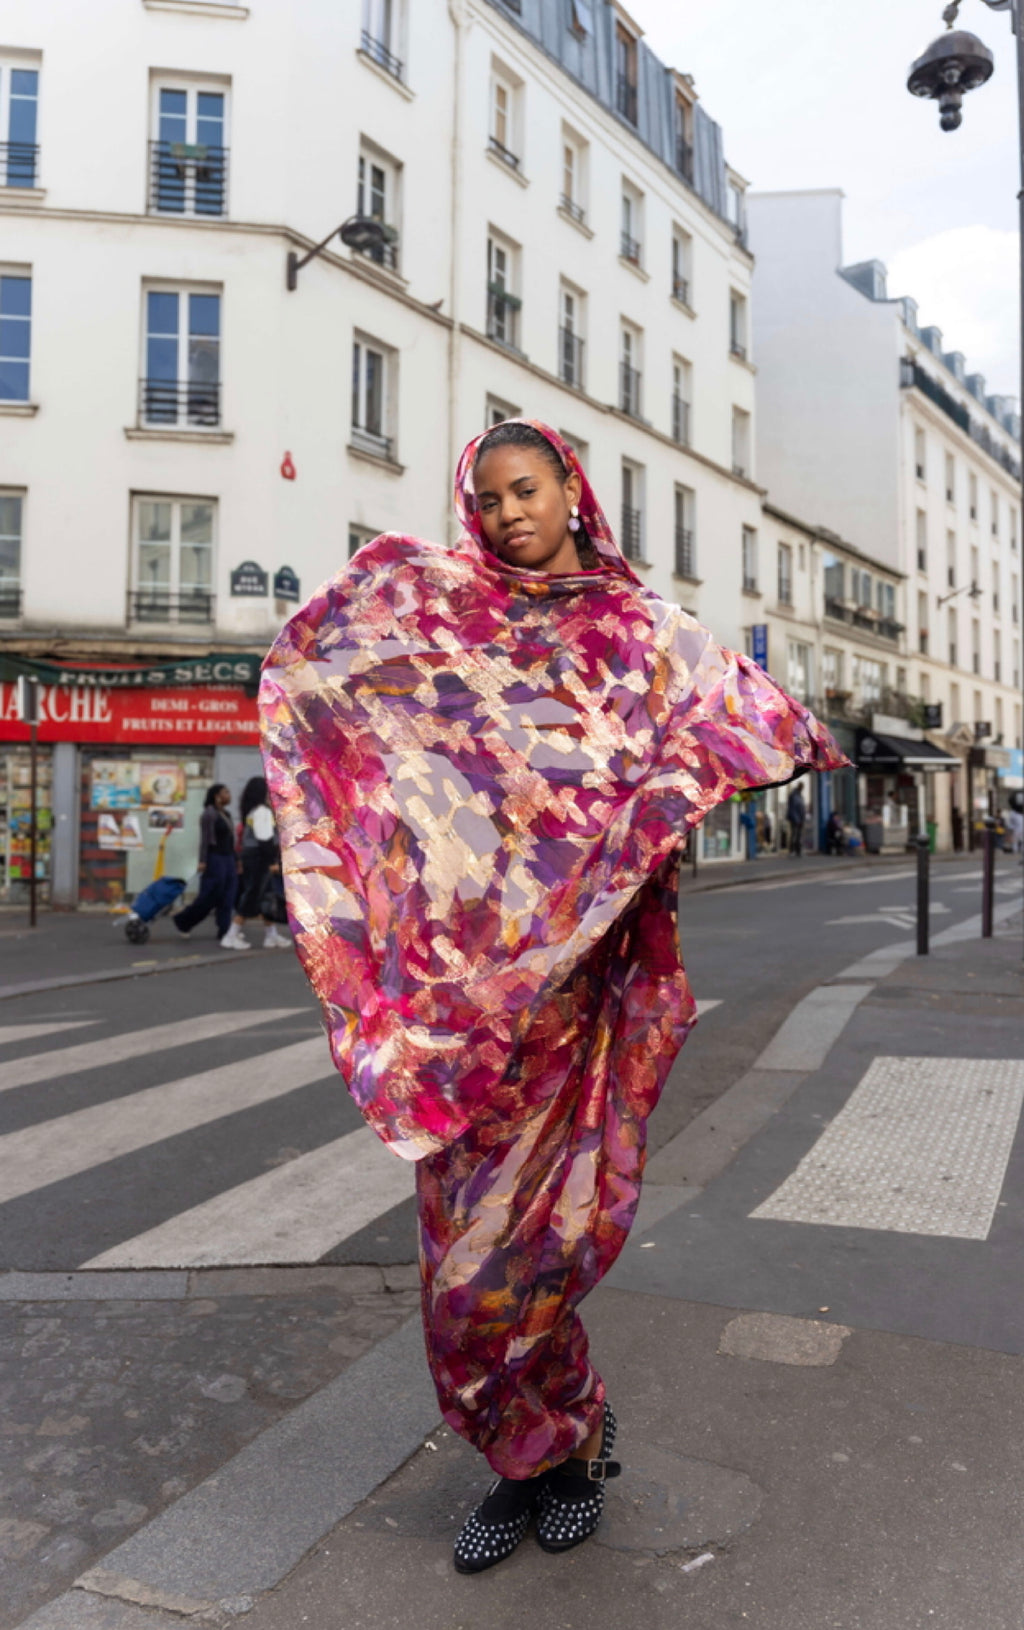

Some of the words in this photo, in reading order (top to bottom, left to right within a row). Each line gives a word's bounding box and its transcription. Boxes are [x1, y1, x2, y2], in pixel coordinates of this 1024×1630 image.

[175, 662, 251, 681] SECS
[0, 684, 112, 722] ARCHE
[151, 698, 188, 712] DEMI
[198, 699, 239, 713] GROS
[122, 718, 173, 731] FRUITS
[175, 719, 195, 732] ET
[197, 720, 260, 733] LEGUME
